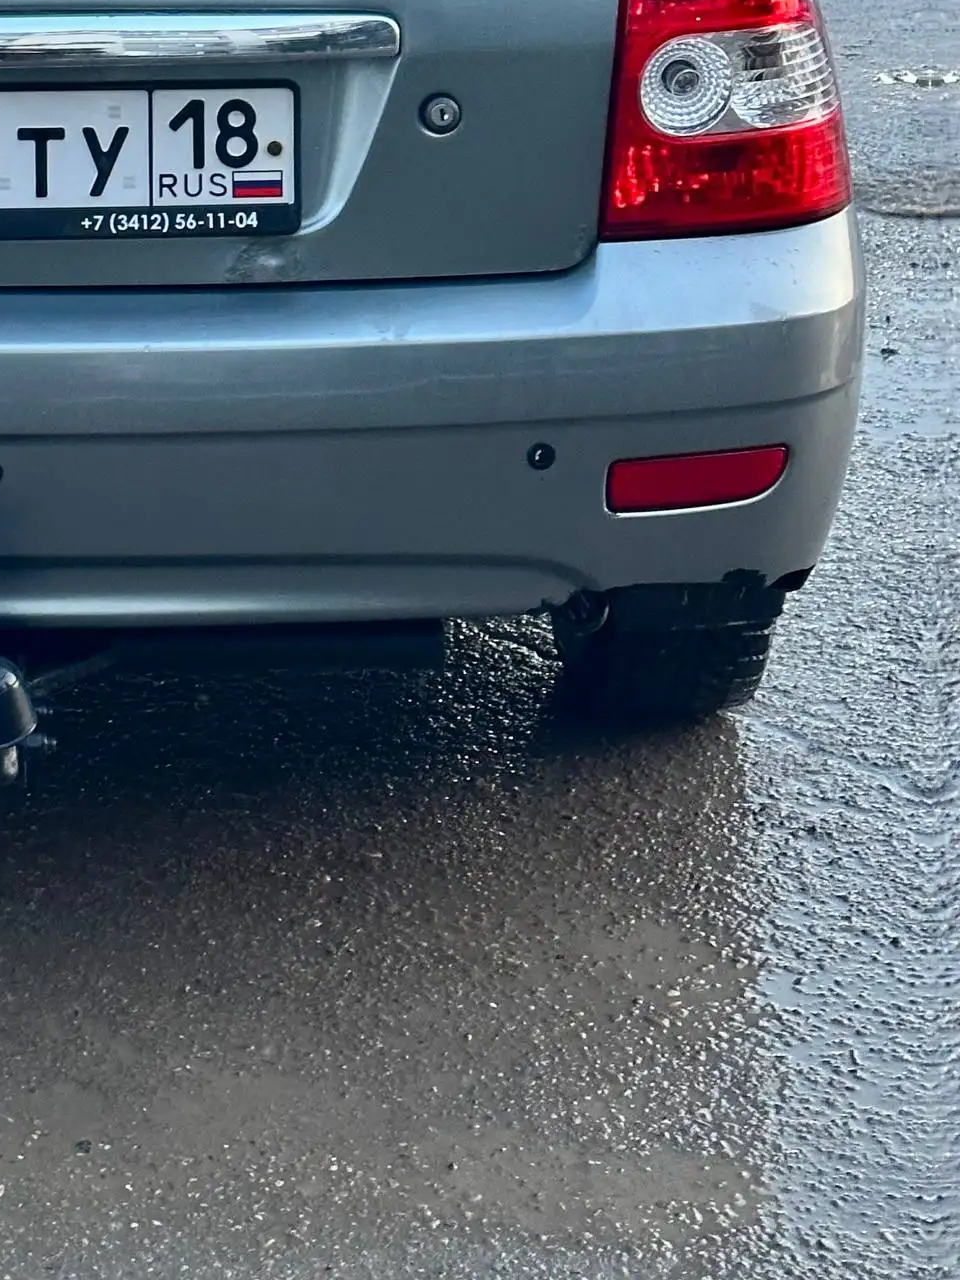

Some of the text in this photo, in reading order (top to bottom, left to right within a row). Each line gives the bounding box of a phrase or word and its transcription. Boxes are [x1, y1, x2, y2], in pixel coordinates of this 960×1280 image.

[168, 98, 259, 169] 18
[158, 172, 228, 198] RUS
[80, 211, 258, 234] +7 (3412) 56-11-04
